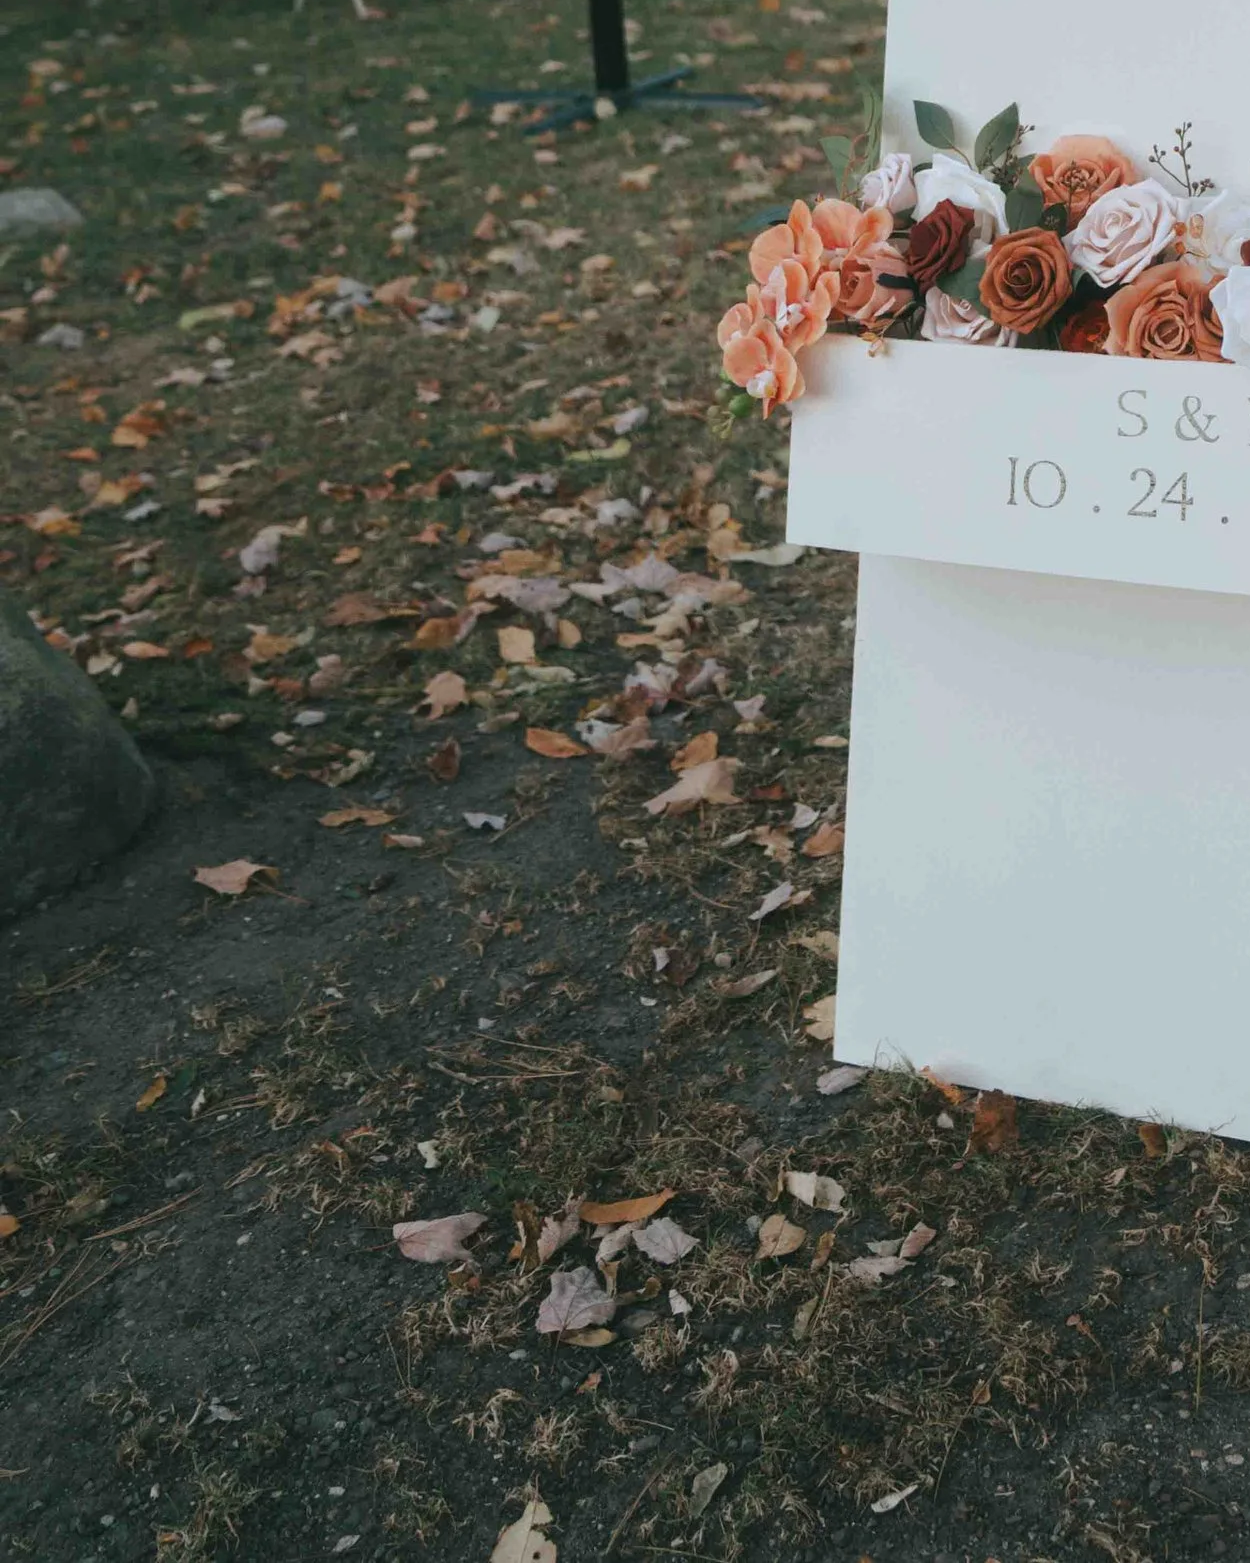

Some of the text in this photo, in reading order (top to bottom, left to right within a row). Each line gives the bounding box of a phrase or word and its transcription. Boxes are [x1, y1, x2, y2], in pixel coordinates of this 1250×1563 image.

[1116, 389, 1149, 438] S
[1174, 395, 1220, 444] &
[1126, 467, 1195, 522] 24
